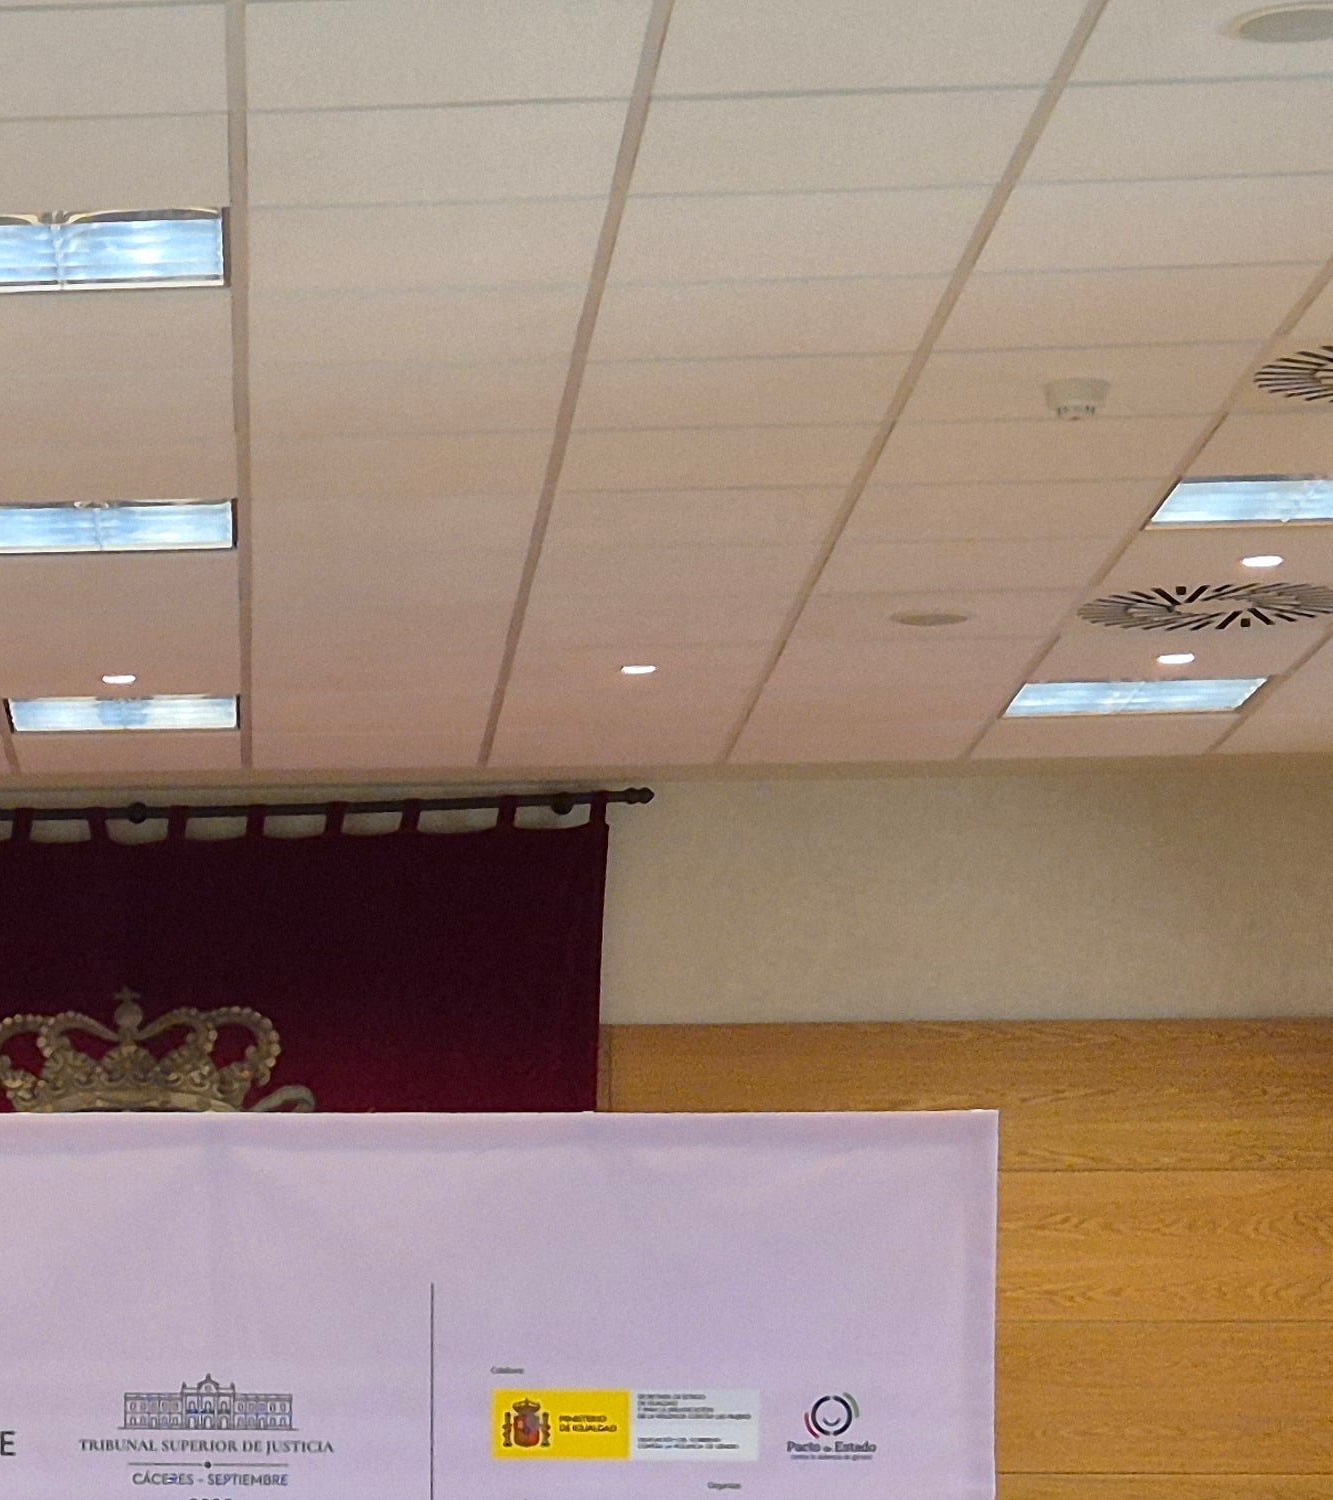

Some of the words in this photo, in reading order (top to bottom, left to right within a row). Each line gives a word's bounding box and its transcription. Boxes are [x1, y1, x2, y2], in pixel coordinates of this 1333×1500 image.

[78, 1438, 158, 1452] TRIBUNAL
[161, 1439, 238, 1453] SUPERIOR
[242, 1440, 263, 1453] DE
[265, 1440, 335, 1456] JUSTICIA
[207, 1473, 289, 1487] SEPTIEMBRE
